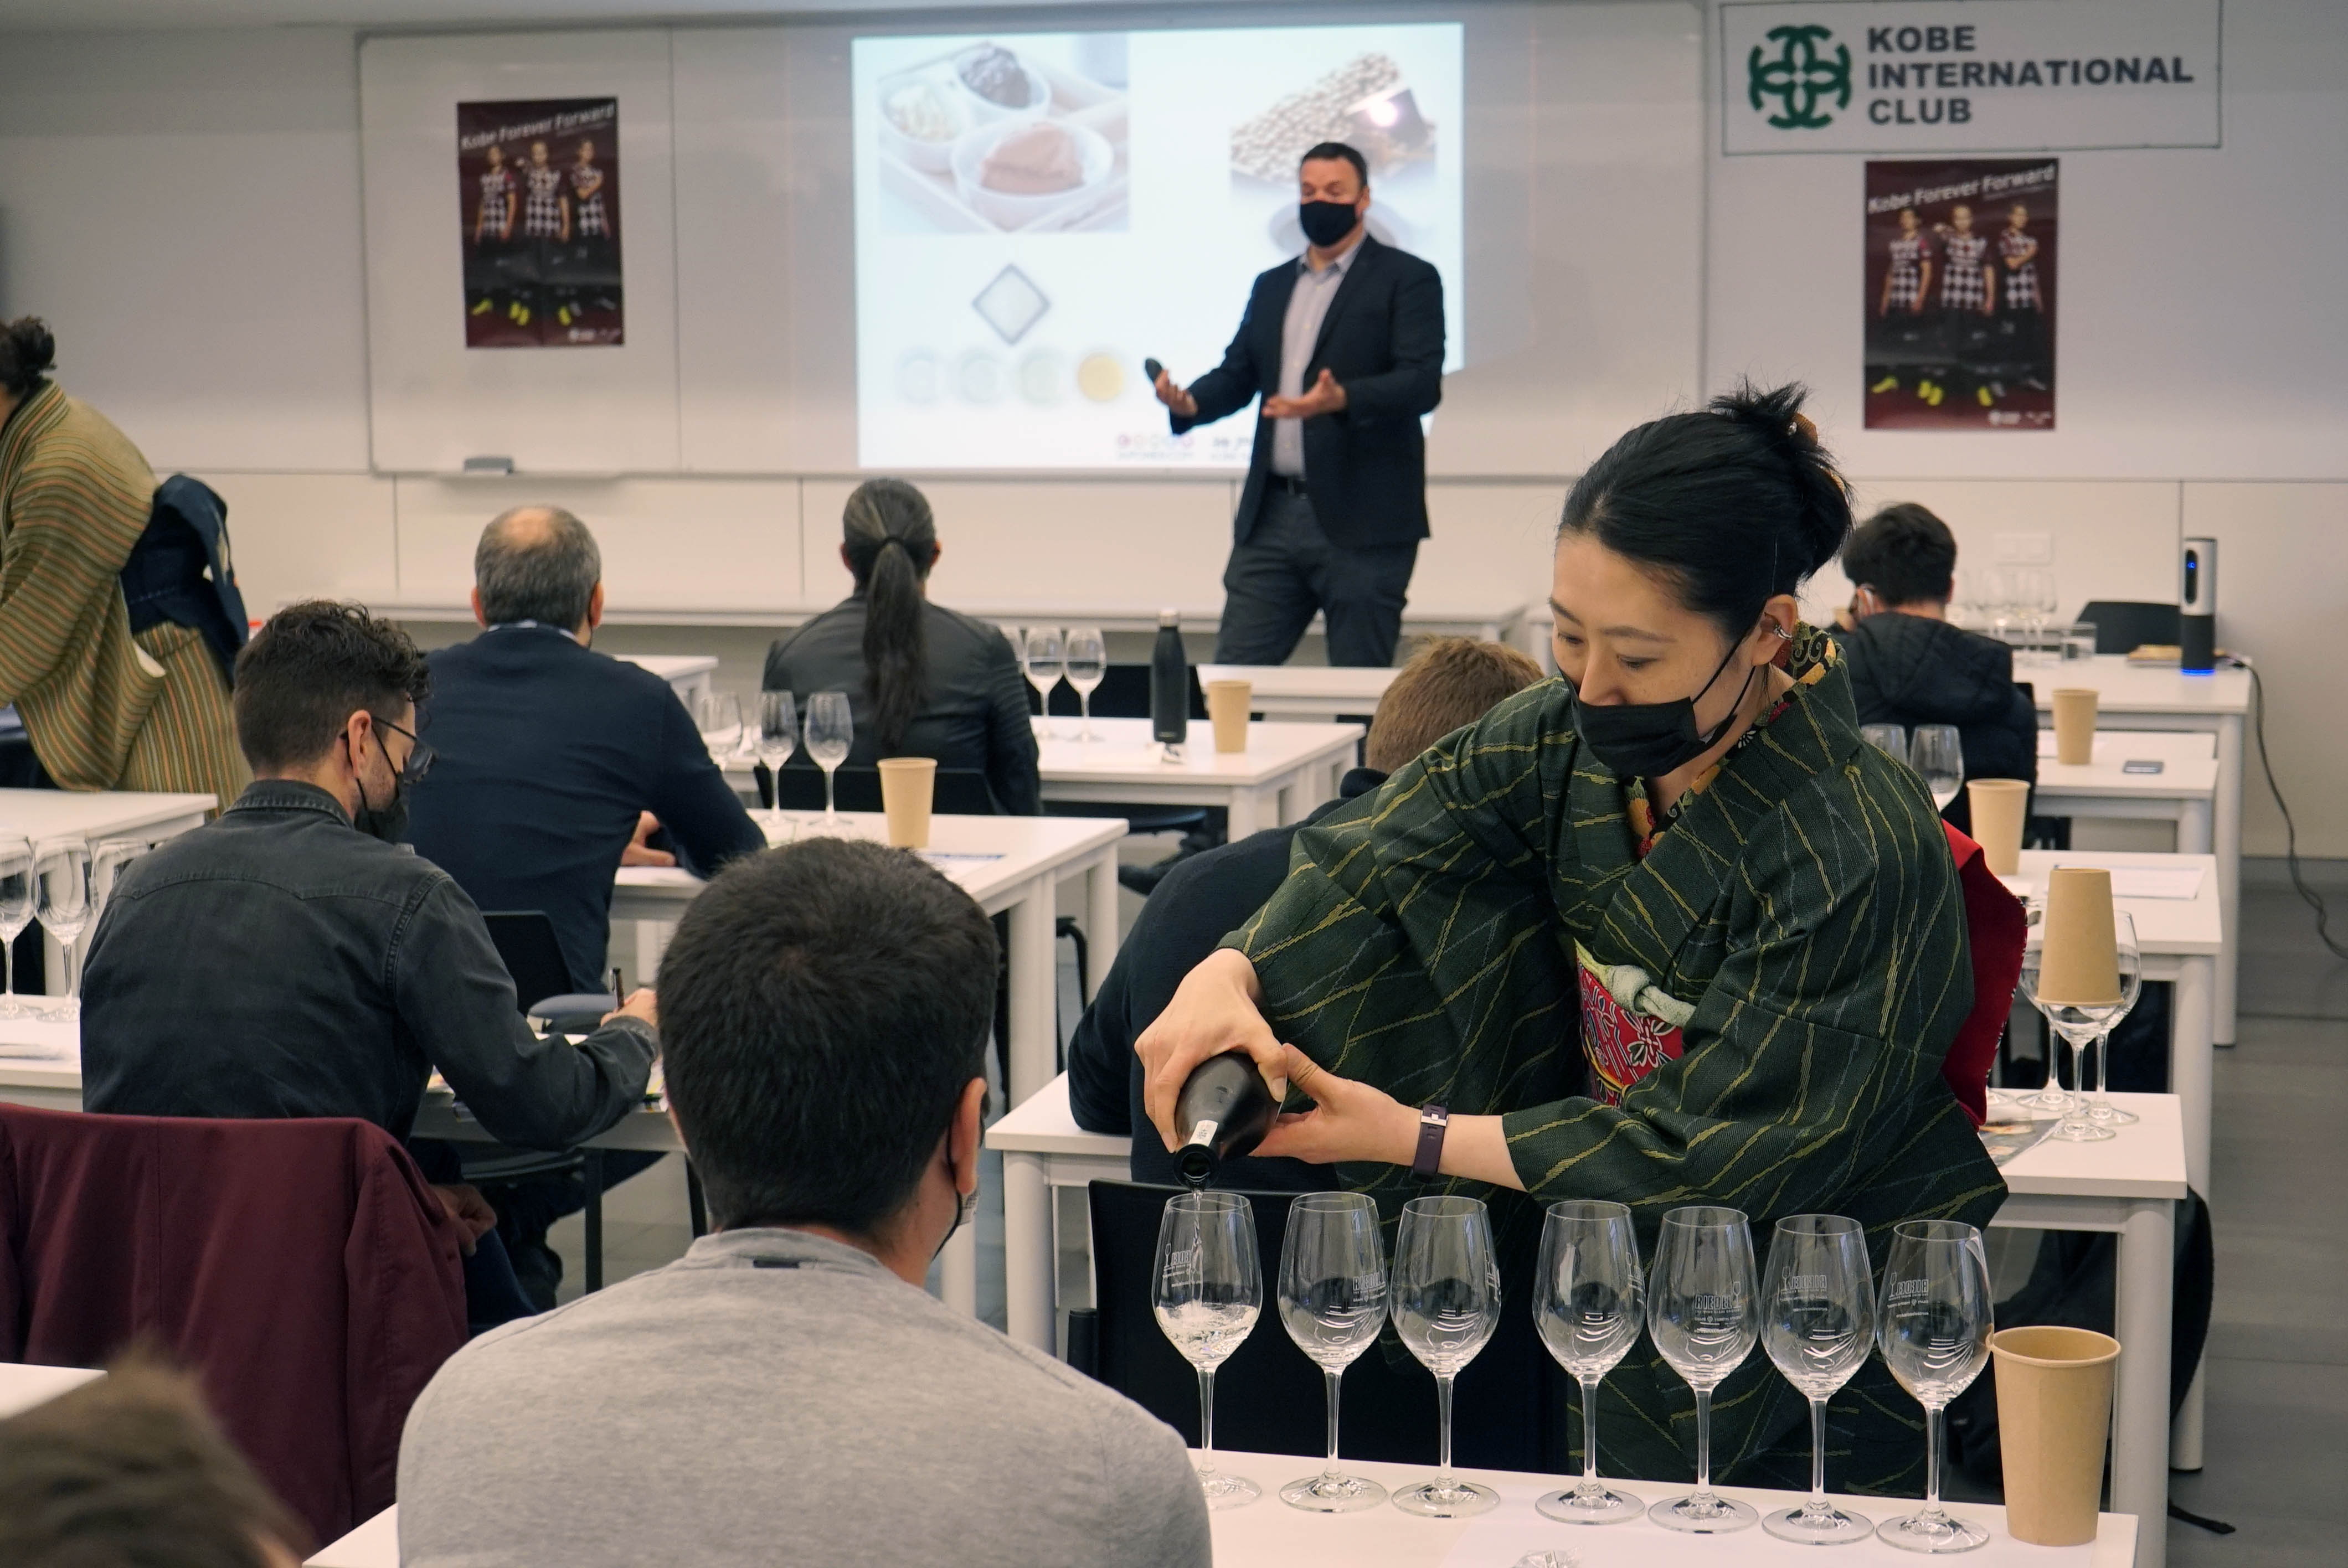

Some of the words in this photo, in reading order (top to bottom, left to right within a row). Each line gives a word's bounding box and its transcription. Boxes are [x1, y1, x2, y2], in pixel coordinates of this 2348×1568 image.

[1867, 26, 1975, 53] KOBE
[1868, 58, 2193, 89] INTERNATIONAL
[1868, 98, 1971, 125] CLUB
[461, 132, 497, 150] Kobe
[499, 118, 553, 142] Forever
[555, 103, 615, 129] Forward
[1868, 194, 1912, 214] Kobe
[1914, 179, 1981, 205] Forever
[1983, 164, 2056, 192] Forward
[1353, 1272, 1381, 1291] RIEDEL
[1695, 1294, 1733, 1310] RIEDEL
